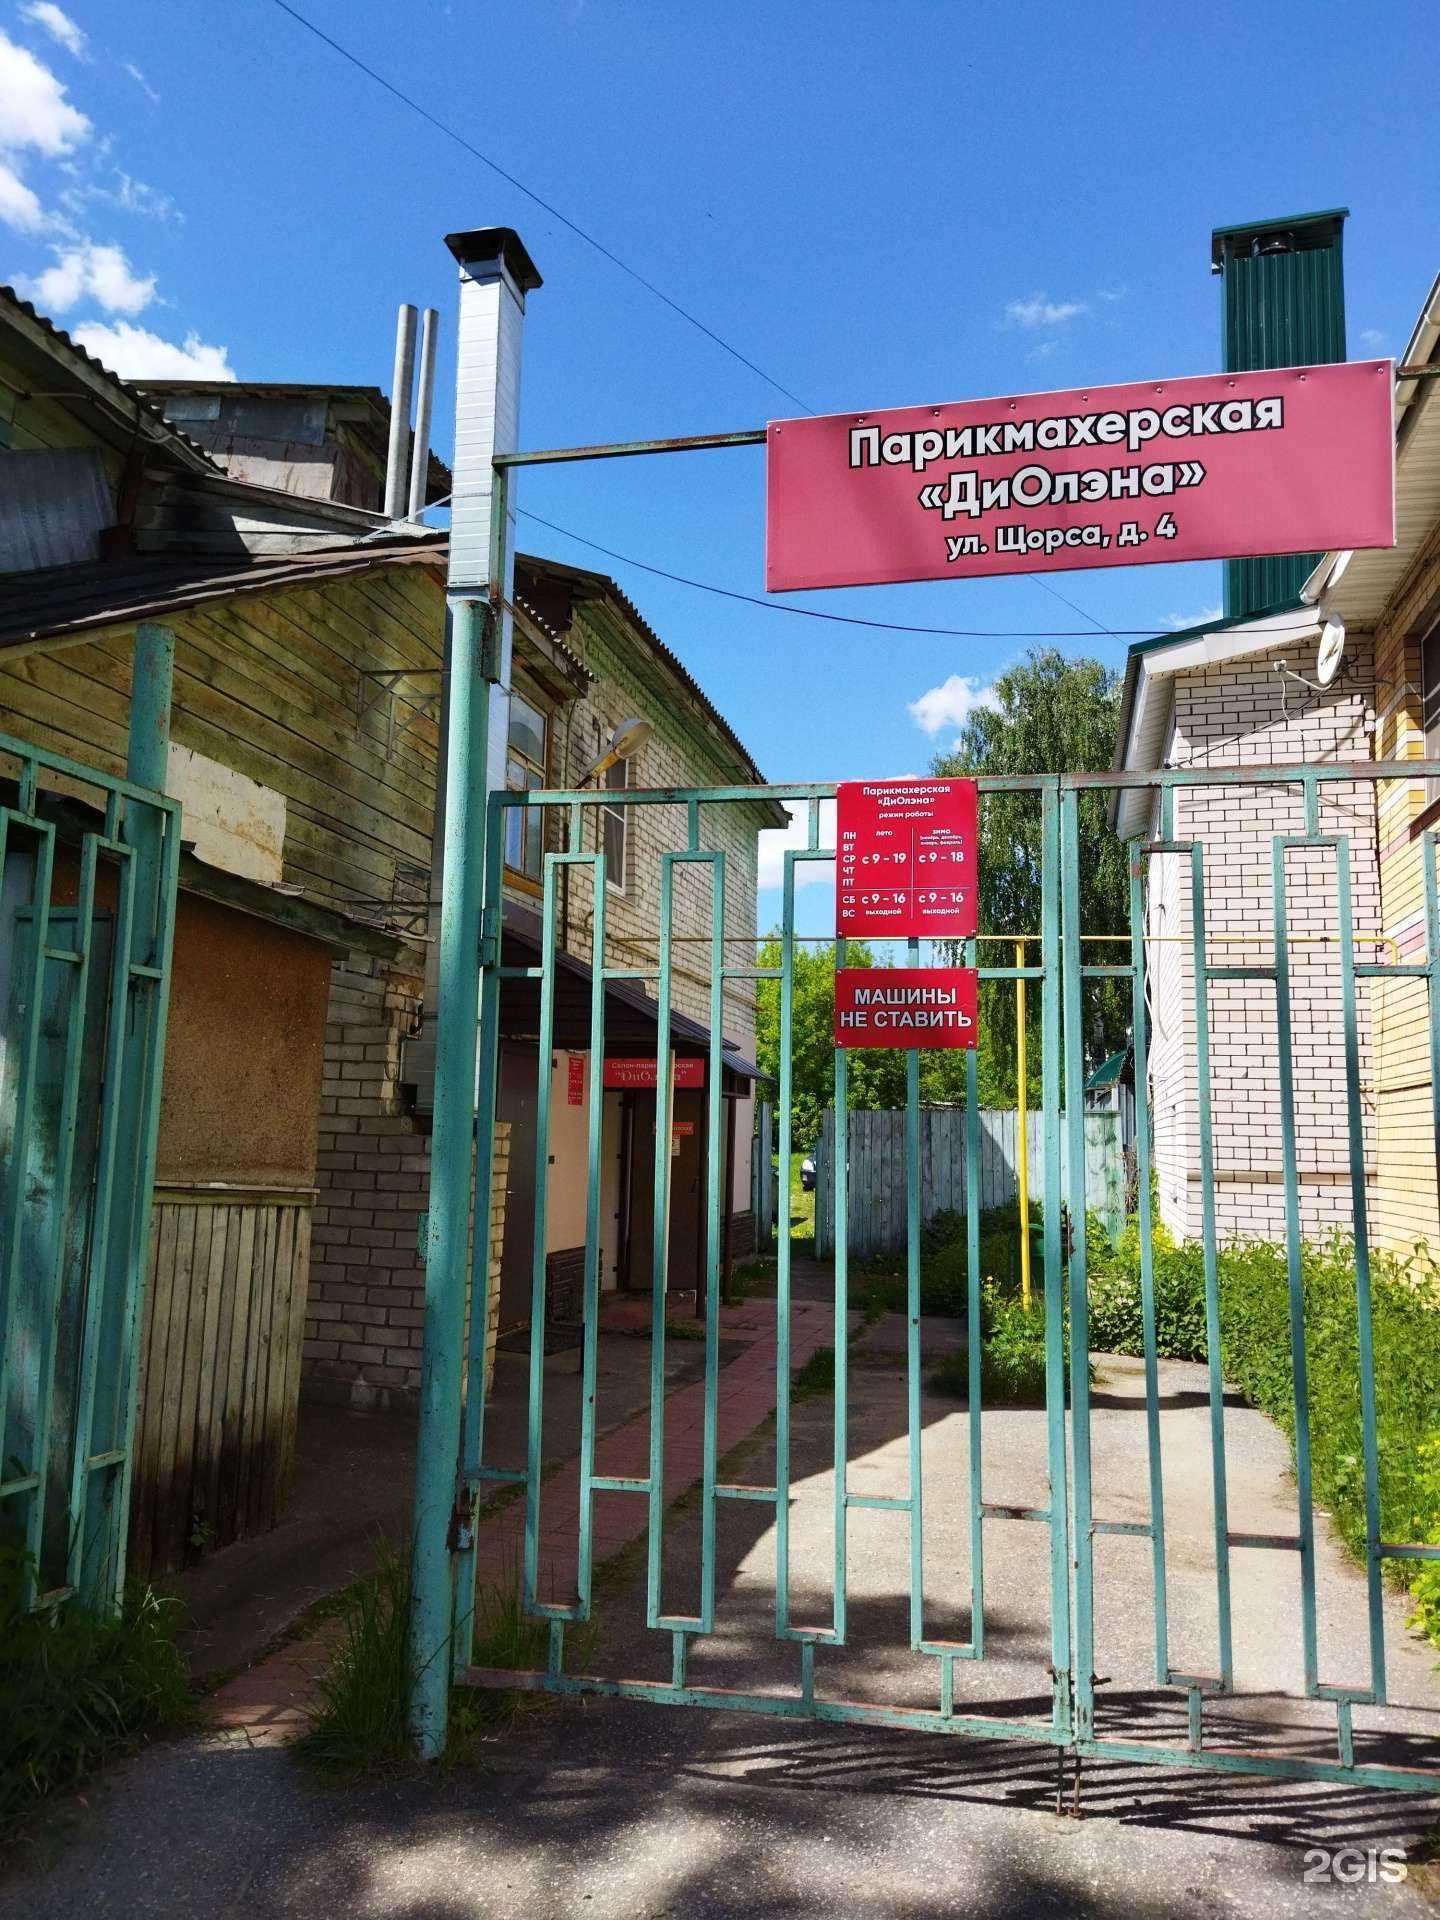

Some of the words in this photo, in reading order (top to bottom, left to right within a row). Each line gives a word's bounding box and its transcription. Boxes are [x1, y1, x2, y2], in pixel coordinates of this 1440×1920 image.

[850, 397, 1283, 470] Парикмахерская
[918, 461, 1206, 519] «ДиОлэна»
[946, 535, 988, 561] ул.
[996, 525, 1111, 553] Щорса,
[1118, 521, 1148, 547] д.
[1155, 512, 1177, 538] 4
[863, 785, 951, 796] Парикмахерская
[878, 796, 935, 806] «ДиОлэна»
[843, 831, 856, 840] ПН
[843, 843, 855, 851] ВТ
[843, 855, 856, 863] СР
[872, 853, 880, 864] 9
[893, 853, 907, 864] 19
[929, 852, 937, 862] 9
[950, 851, 964, 862] 18
[843, 866, 855, 875] ЧТ
[842, 878, 855, 886] ПТ
[842, 895, 856, 904] СБ
[871, 893, 880, 904] 9
[893, 893, 906, 904] 16
[929, 892, 937, 903] 9
[950, 892, 964, 903] 16
[842, 909, 855, 918] ВС
[854, 988, 956, 1005] МАШИНЫ
[840, 1011, 868, 1028] НЕ
[874, 1010, 972, 1028] СТАВИТЬ
